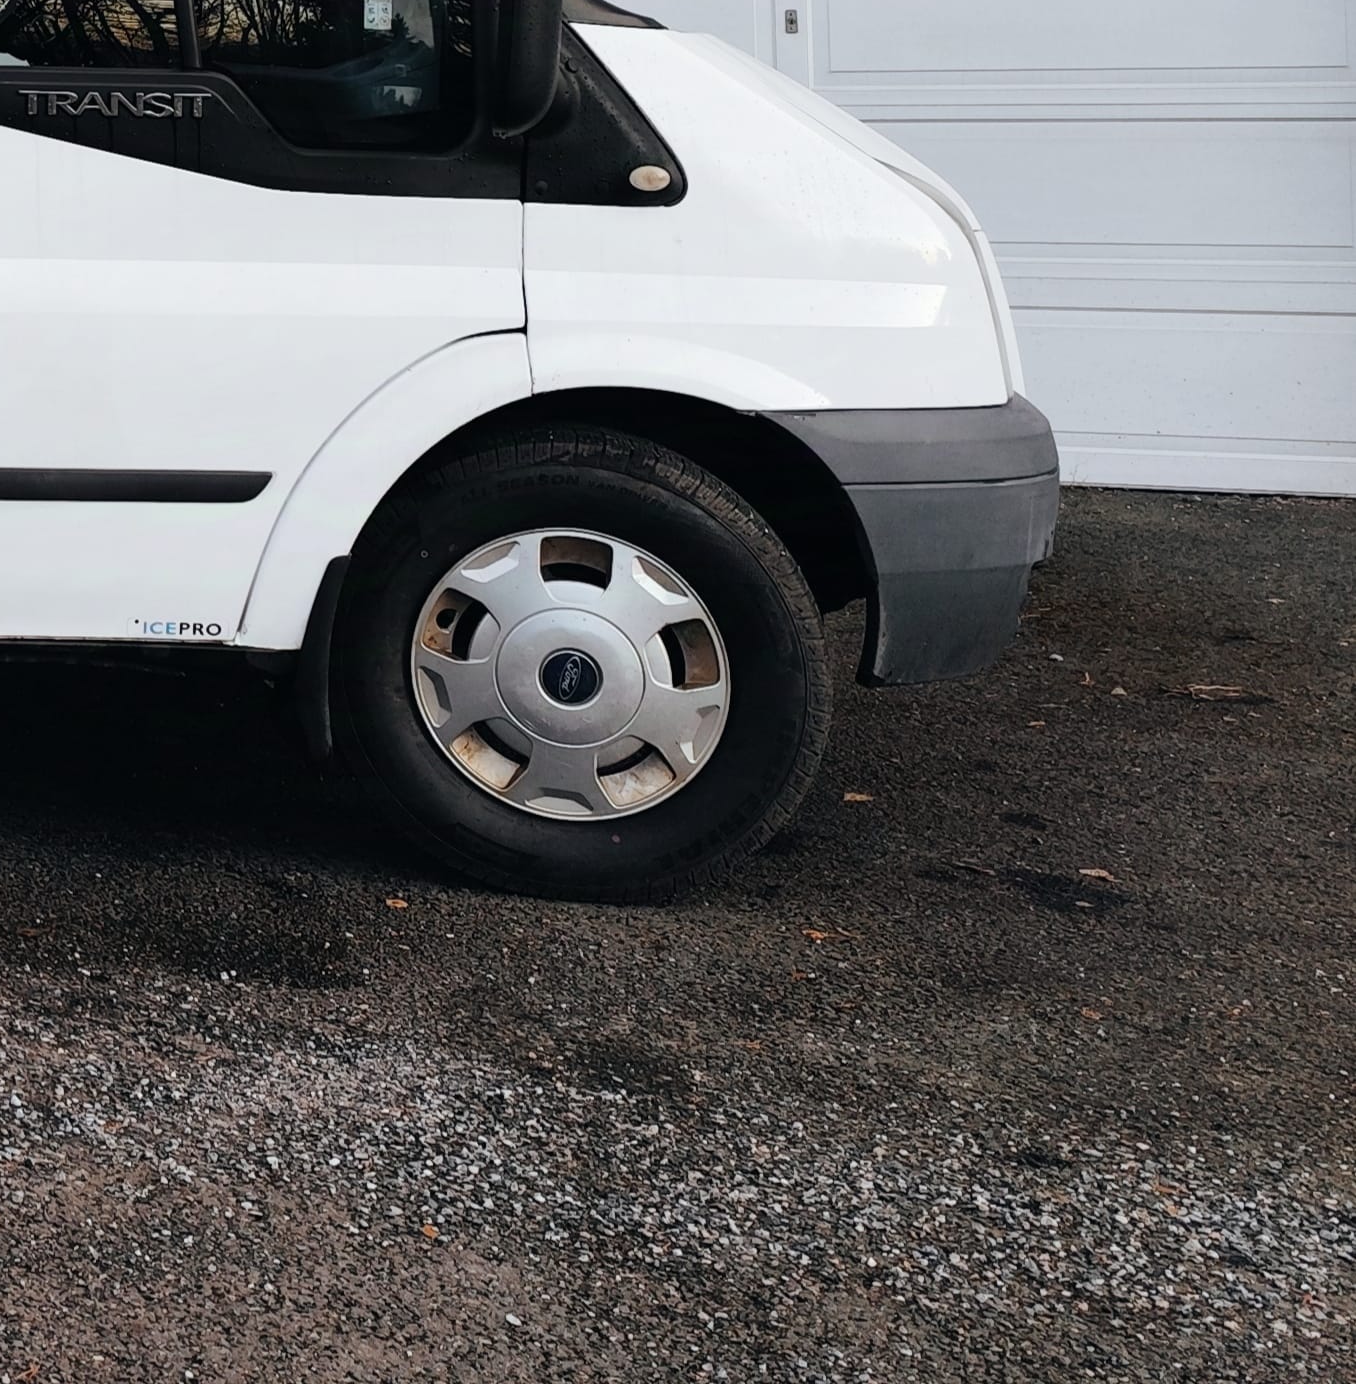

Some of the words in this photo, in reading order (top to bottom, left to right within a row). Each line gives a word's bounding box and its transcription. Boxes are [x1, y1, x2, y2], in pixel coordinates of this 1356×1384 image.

[18, 90, 212, 117] TRANSIT
[144, 622, 222, 636] ICEPRO
[561, 663, 579, 692] Ford
